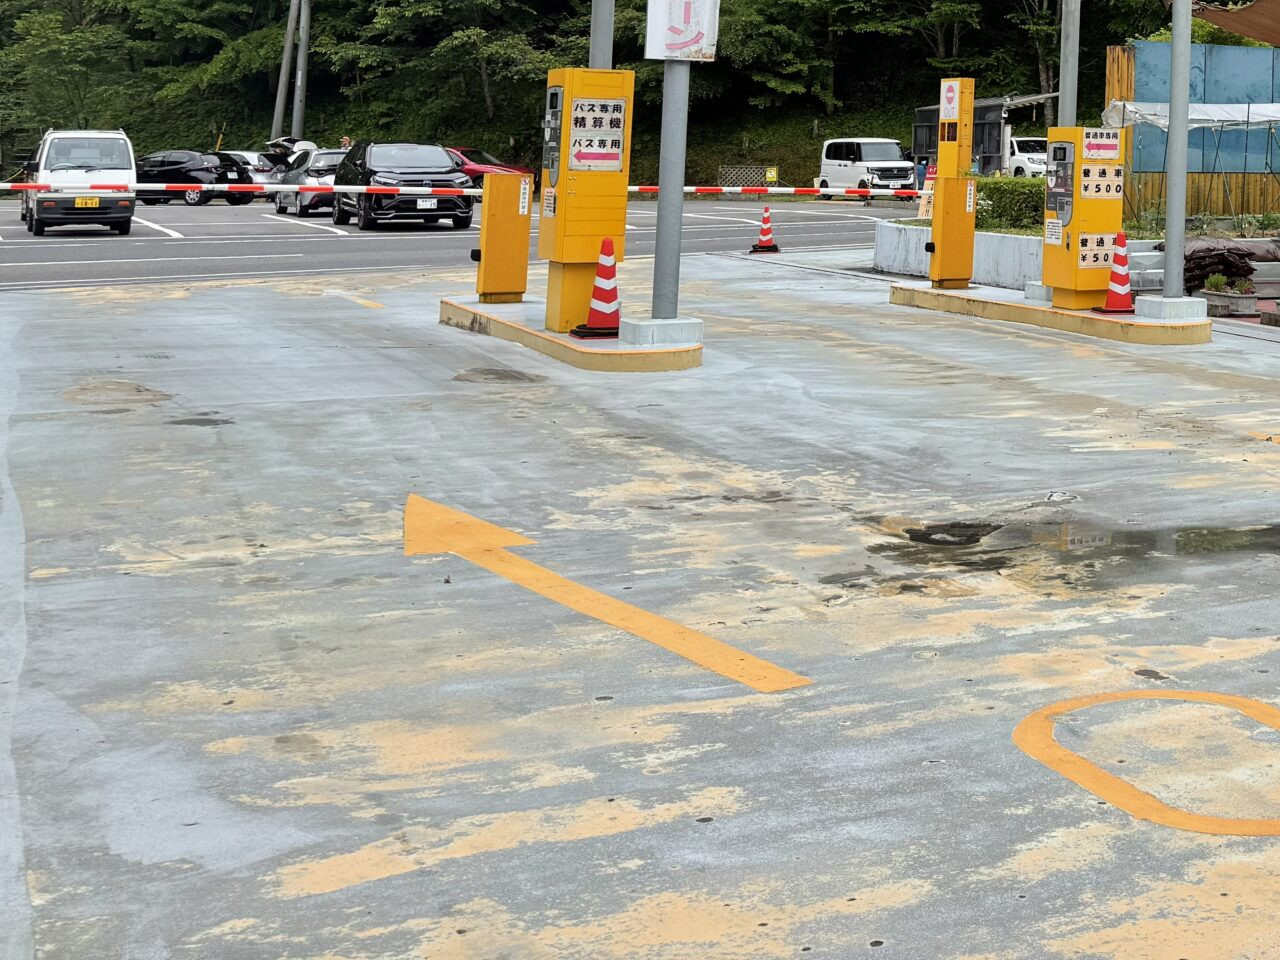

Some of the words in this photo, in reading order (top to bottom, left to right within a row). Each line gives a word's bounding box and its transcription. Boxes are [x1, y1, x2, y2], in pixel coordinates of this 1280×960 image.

[574, 103, 622, 113] バス専用
[573, 116, 622, 129] 精算機
[1085, 132, 1119, 140] 普通車専用
[572, 138, 621, 149] バス専用
[1082, 168, 1123, 178] 普通車
[1083, 184, 1122, 193] ¥500
